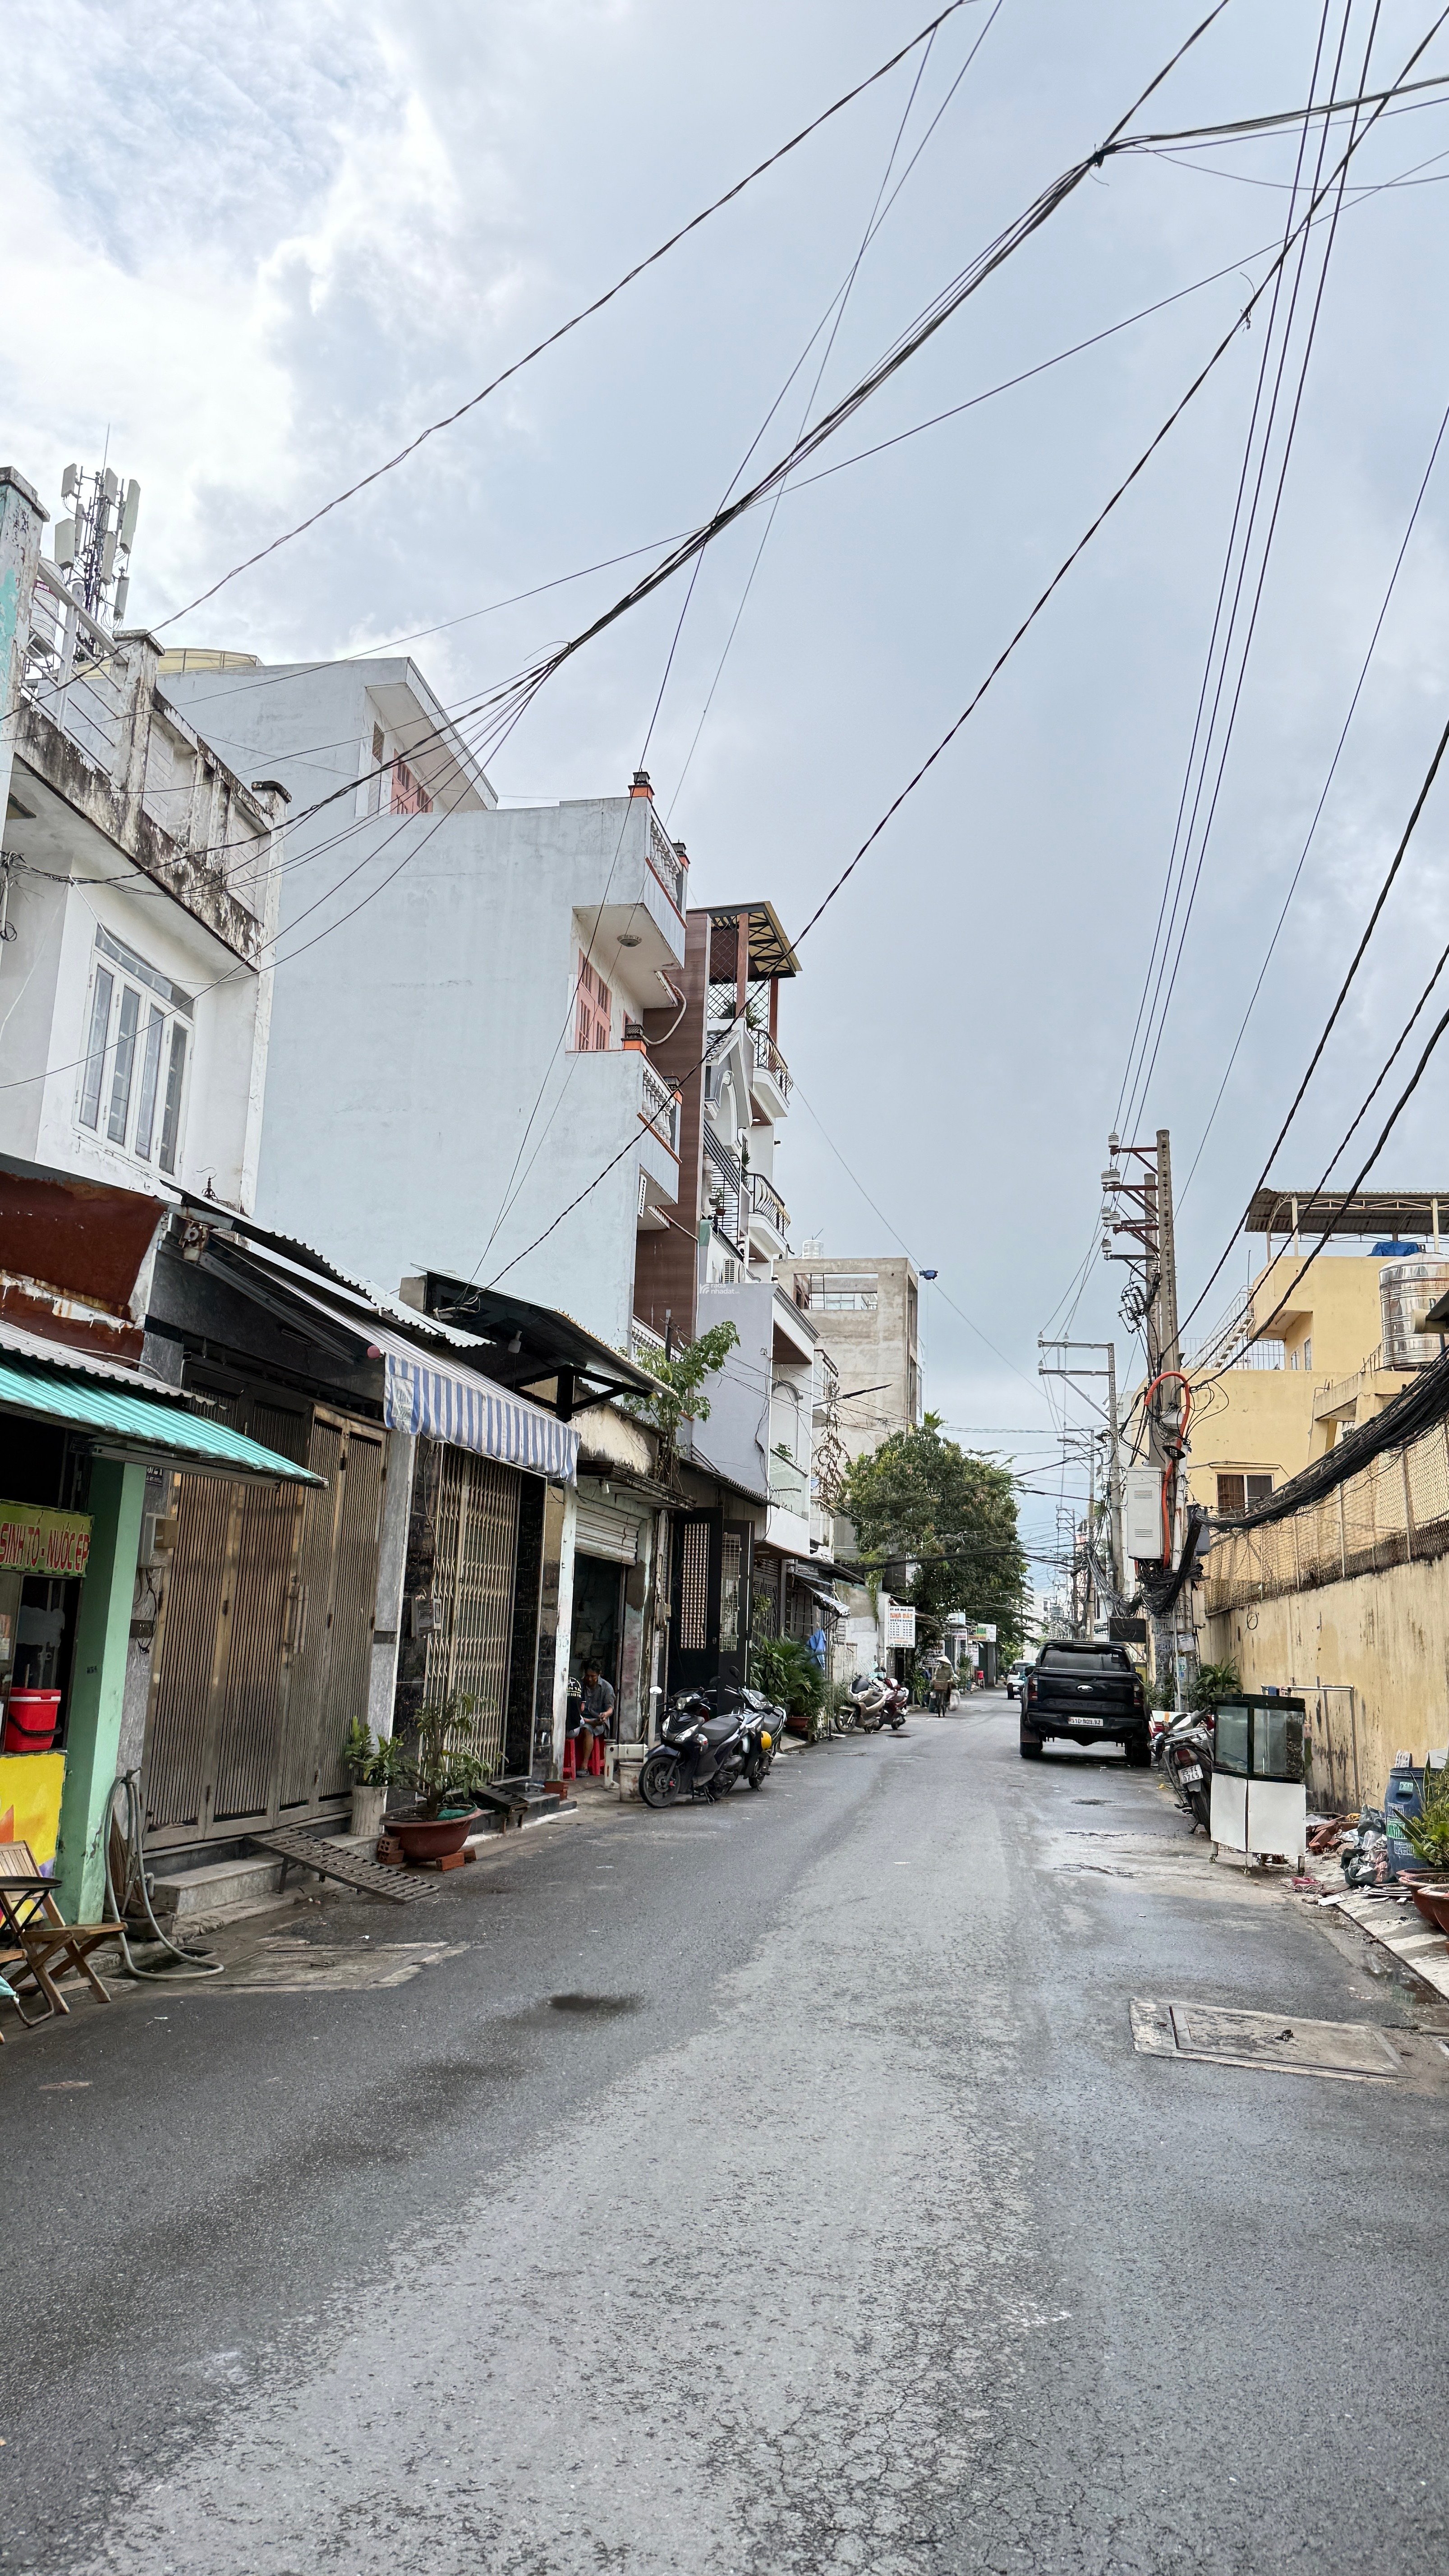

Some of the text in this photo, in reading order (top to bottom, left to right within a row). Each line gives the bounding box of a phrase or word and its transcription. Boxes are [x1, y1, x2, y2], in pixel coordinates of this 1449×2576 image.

[0, 1523, 26, 1565] SINH
[46, 1522, 76, 1570] NƯỚC
[74, 1523, 90, 1571] ÉP
